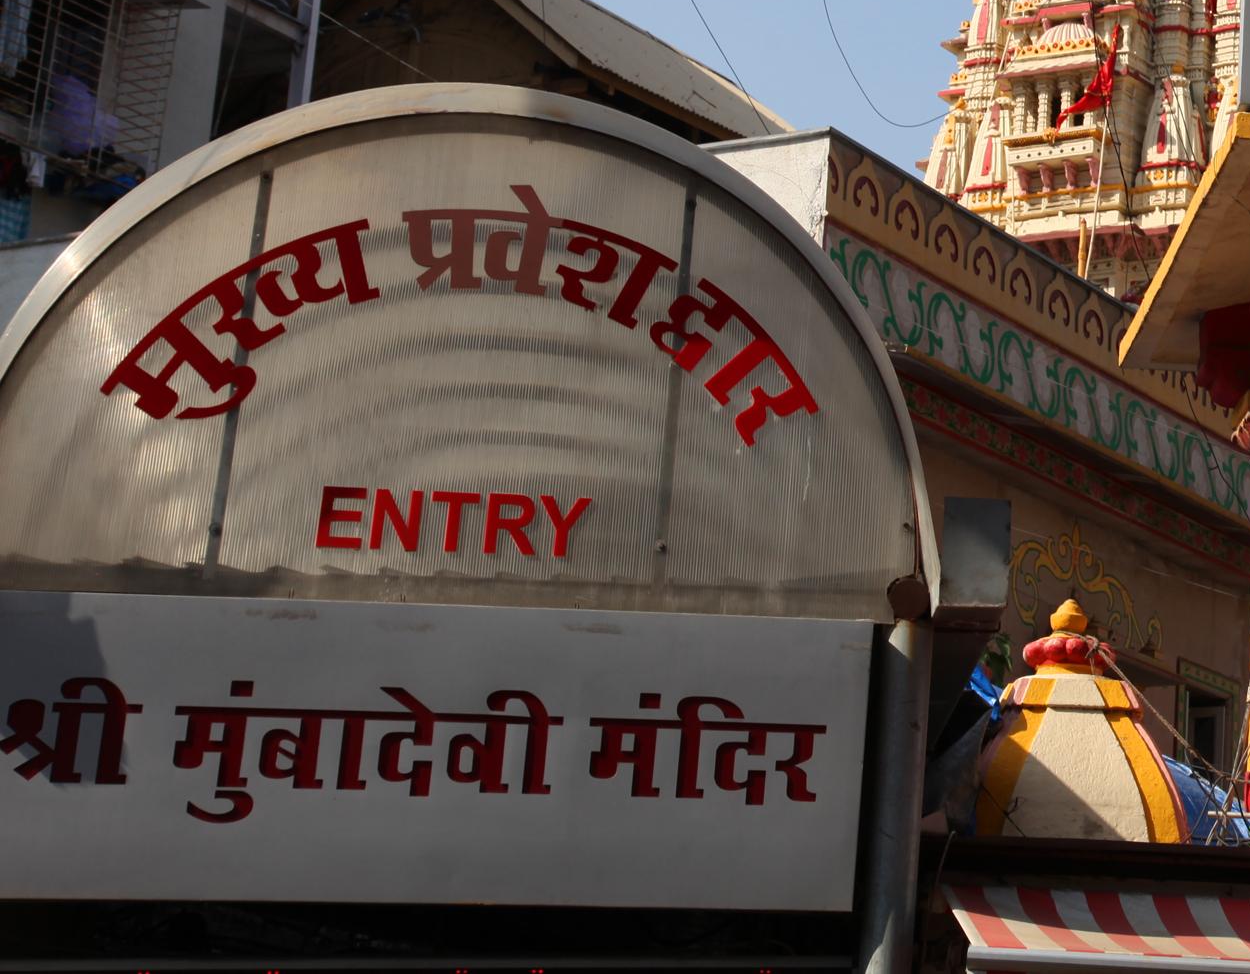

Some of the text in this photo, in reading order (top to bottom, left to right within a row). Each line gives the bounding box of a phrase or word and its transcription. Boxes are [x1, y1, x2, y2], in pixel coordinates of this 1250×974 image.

[99, 184, 820, 447] मुख्य प्रवेश द्वार
[315, 485, 593, 558] ENTRY
[0, 677, 828, 824] श्री मुंबादेवी मंदिर
